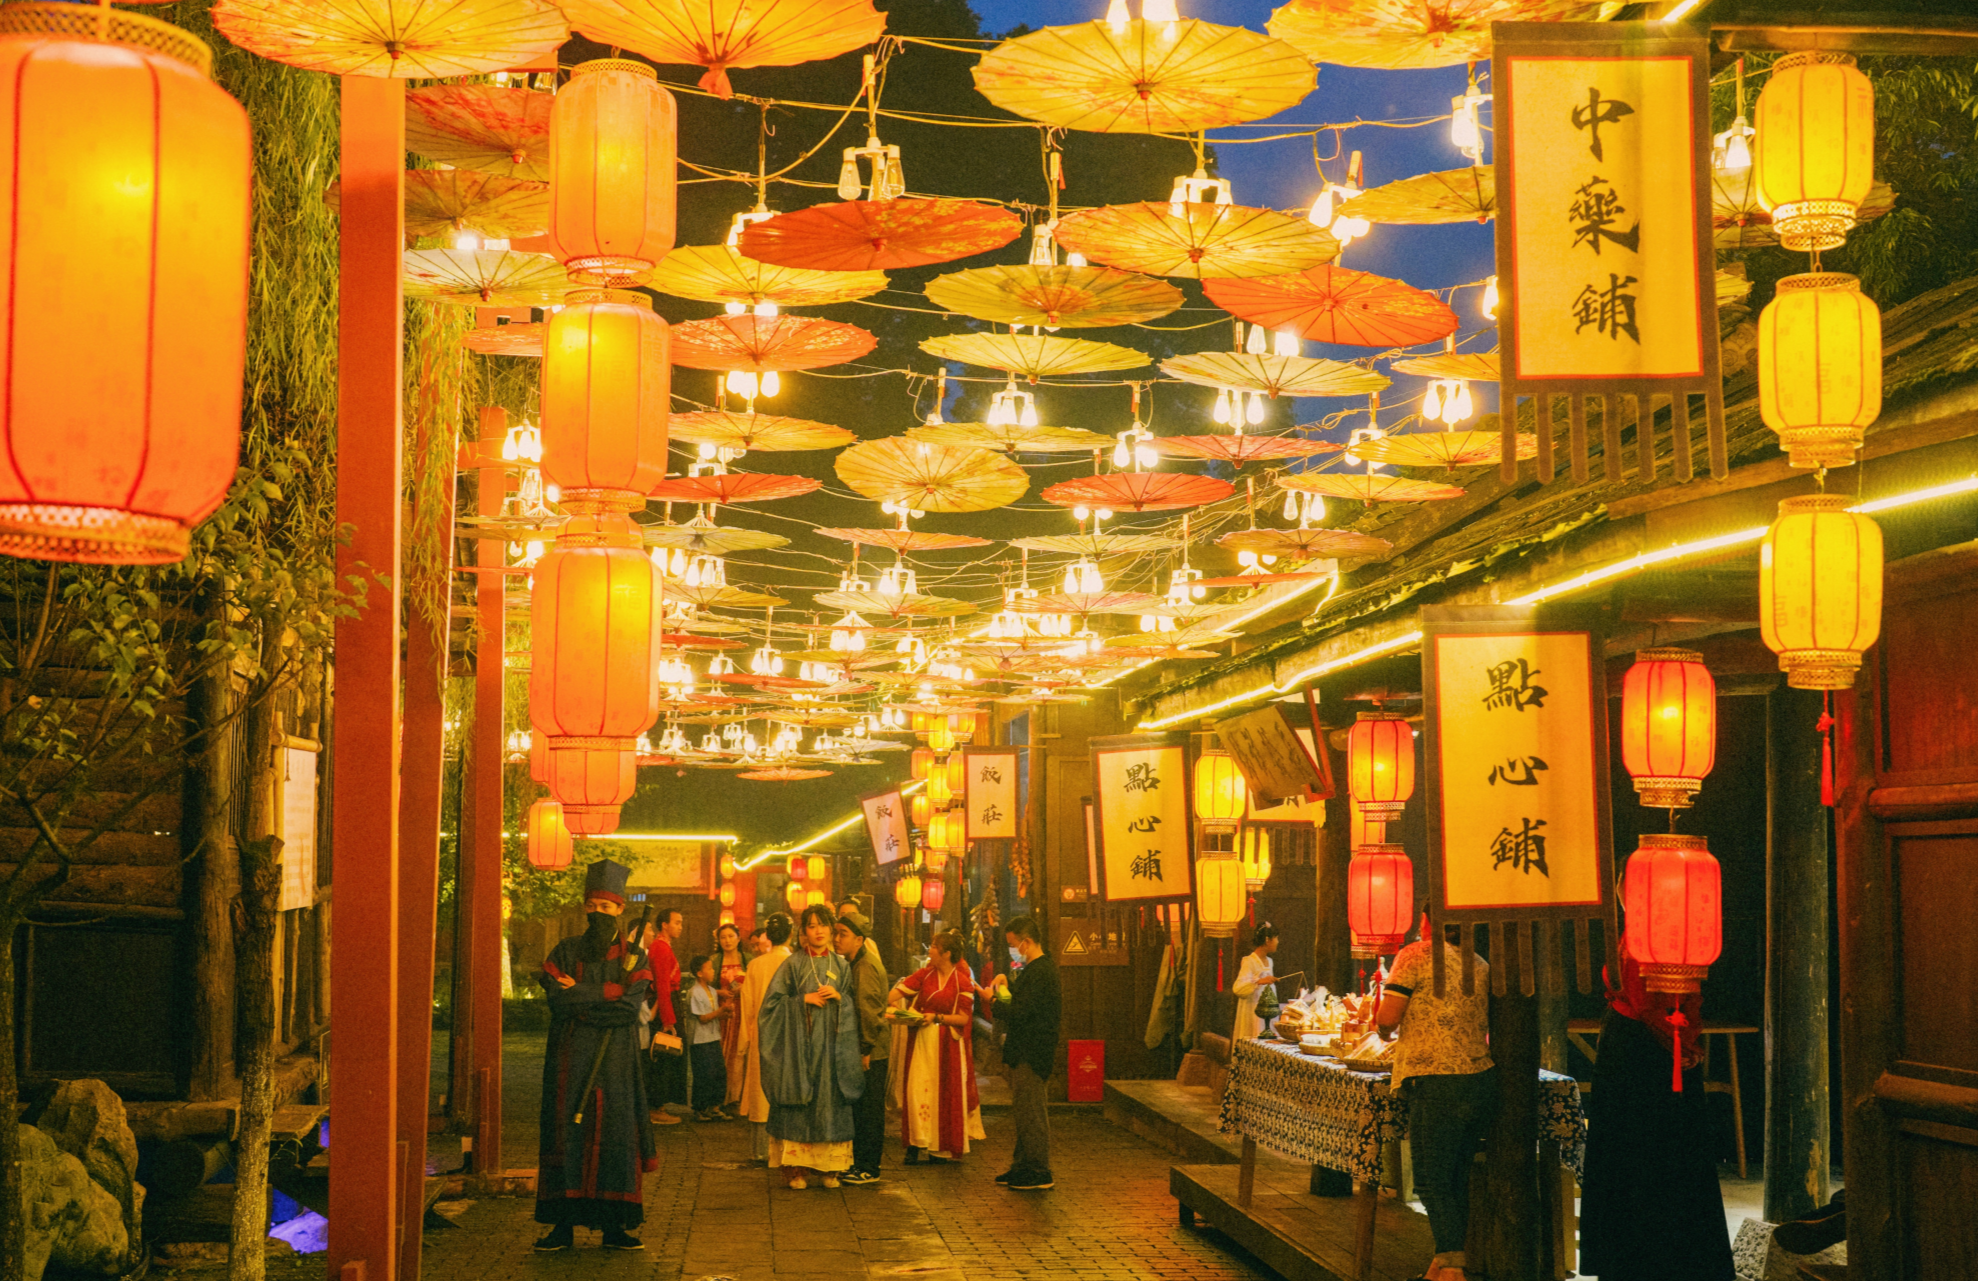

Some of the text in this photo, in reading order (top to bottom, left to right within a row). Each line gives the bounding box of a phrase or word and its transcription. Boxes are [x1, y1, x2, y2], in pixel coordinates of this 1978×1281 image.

[1569, 87, 1640, 345] 中藥鋪
[1124, 762, 1164, 882] 點心鋪
[1482, 658, 1549, 878] 點心鋪
